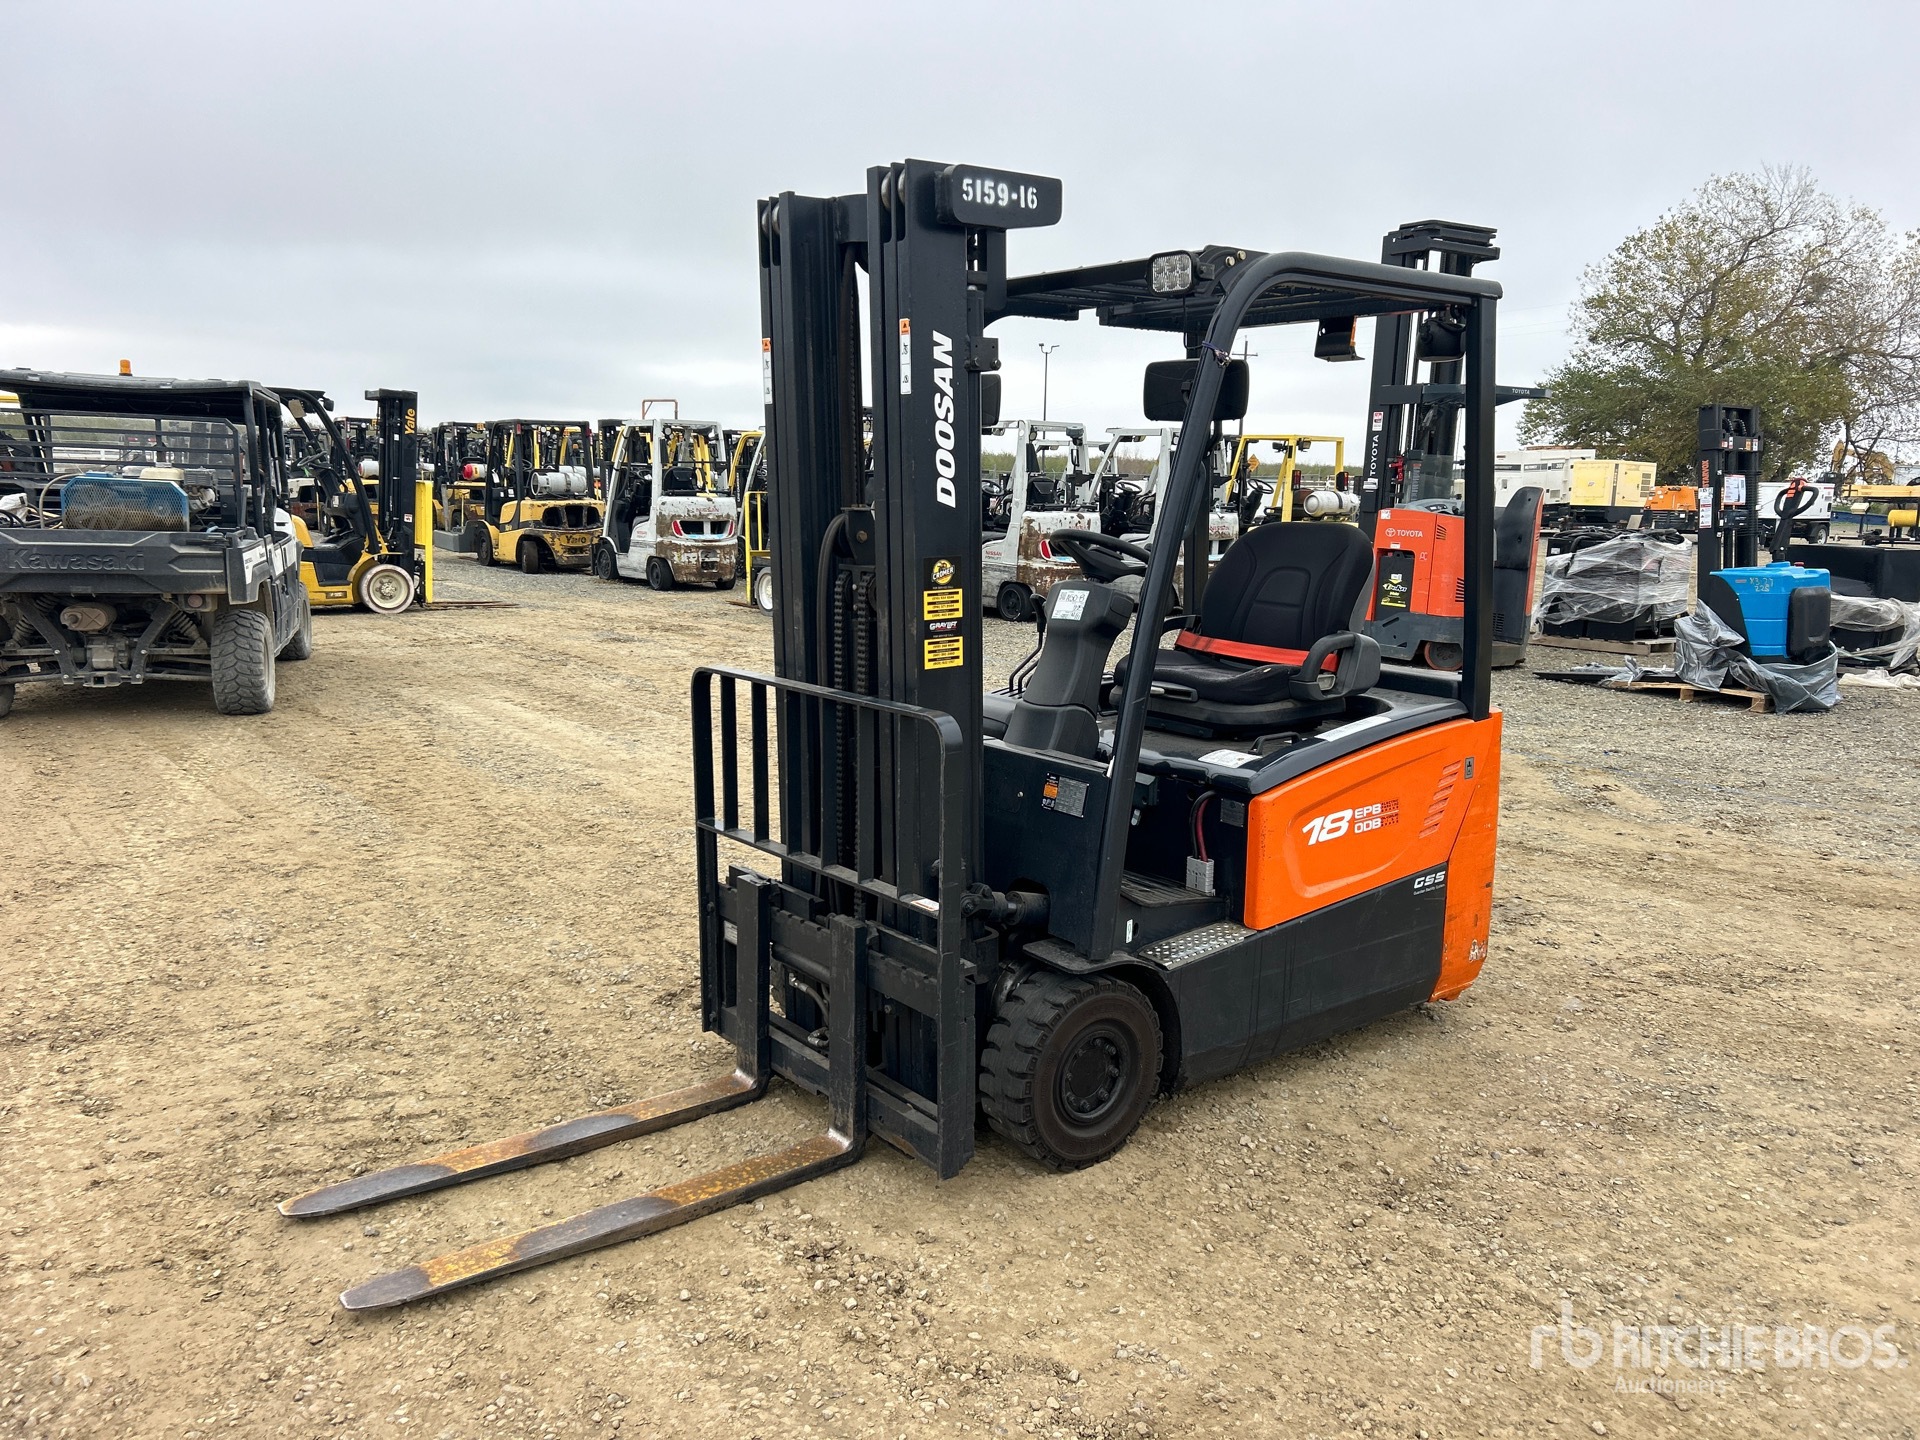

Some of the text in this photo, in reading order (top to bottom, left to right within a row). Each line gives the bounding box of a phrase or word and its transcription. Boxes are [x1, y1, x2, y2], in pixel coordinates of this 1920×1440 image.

[962, 178, 1038, 210] 5159-16
[404, 408, 416, 435] Yale
[932, 330, 956, 508] DOOSAN
[1369, 434, 1379, 477] TOYOTA
[1396, 529, 1424, 538] TOYOTA
[6, 548, 146, 571] Kawasaki
[932, 565, 955, 581] CROMER
[1354, 803, 1382, 819] EPB
[1302, 808, 1353, 846] 18
[1354, 817, 1382, 834] ODB
[1413, 870, 1446, 889] GSS
